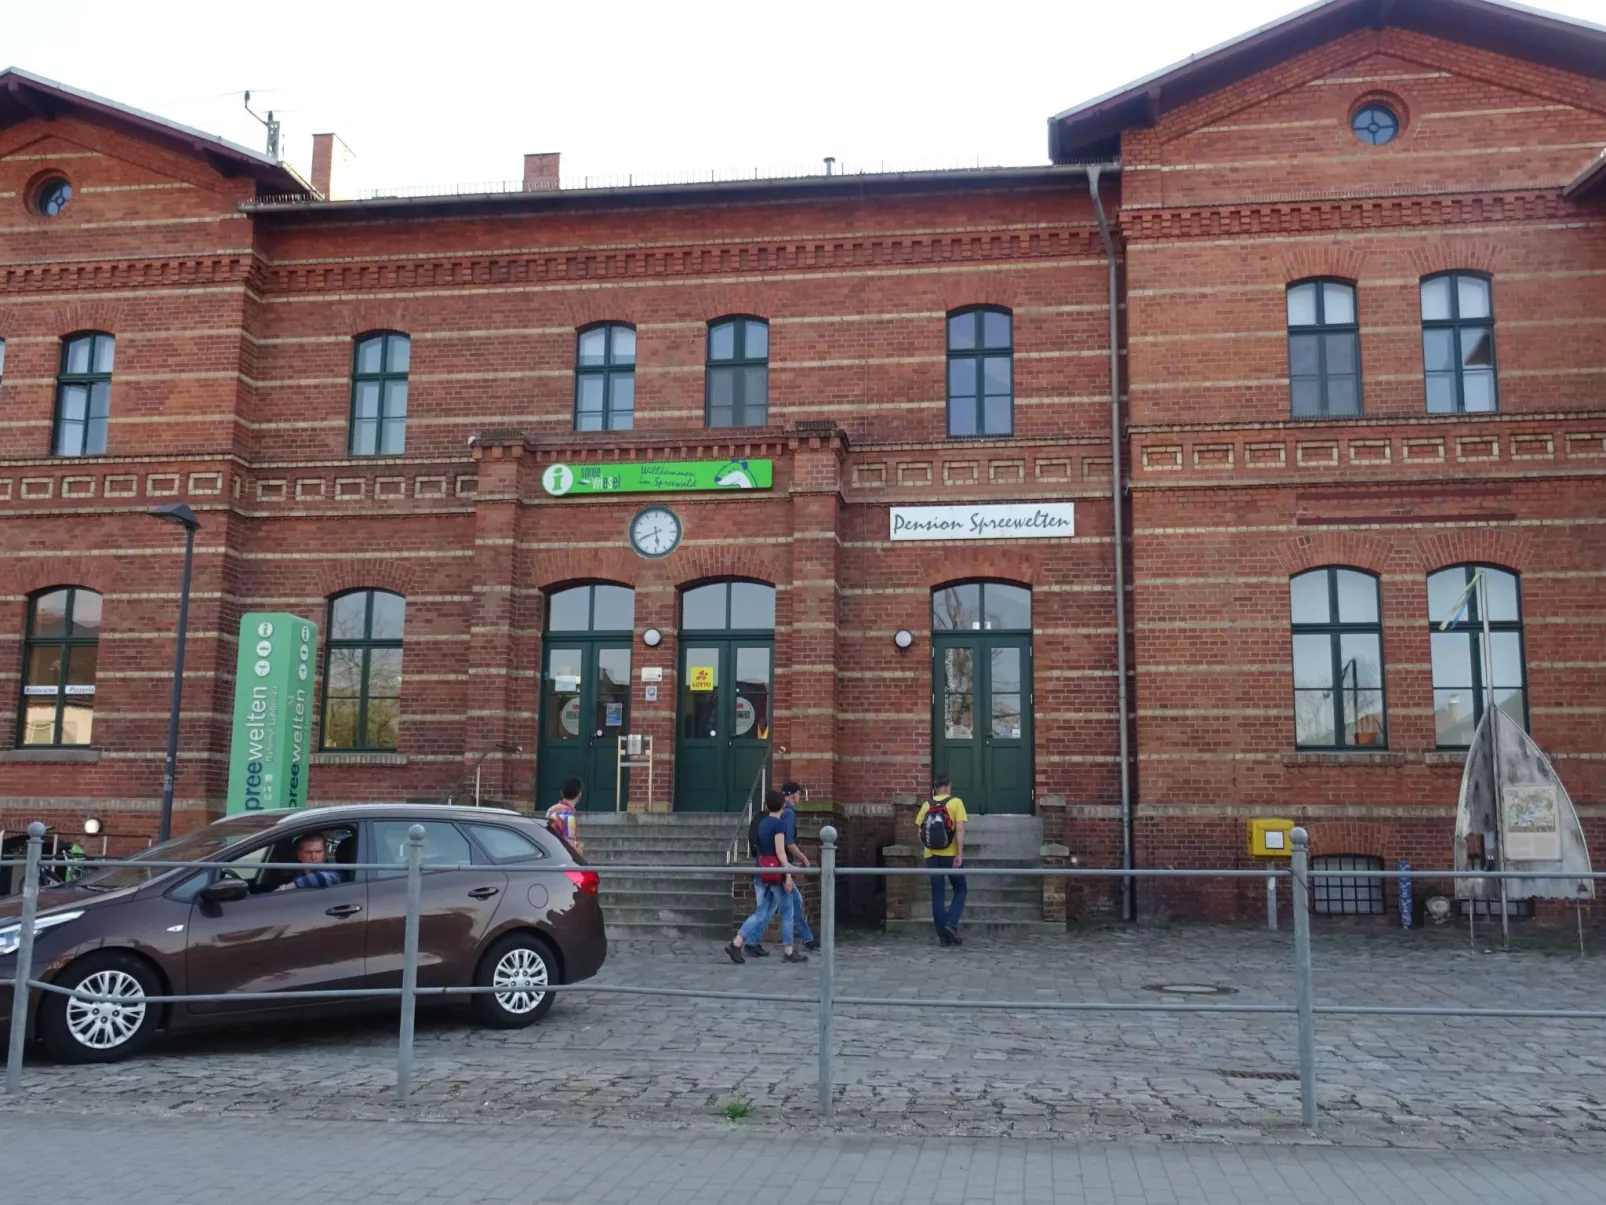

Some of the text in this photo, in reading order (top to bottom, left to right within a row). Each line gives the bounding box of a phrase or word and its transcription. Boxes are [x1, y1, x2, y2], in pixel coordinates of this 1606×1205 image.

[580, 467, 601, 479] spree
[641, 465, 696, 477] Willkommen
[592, 473, 621, 490] wiesel
[638, 477, 697, 487] im Spreewald
[893, 509, 1071, 536] Pension Spreewelten
